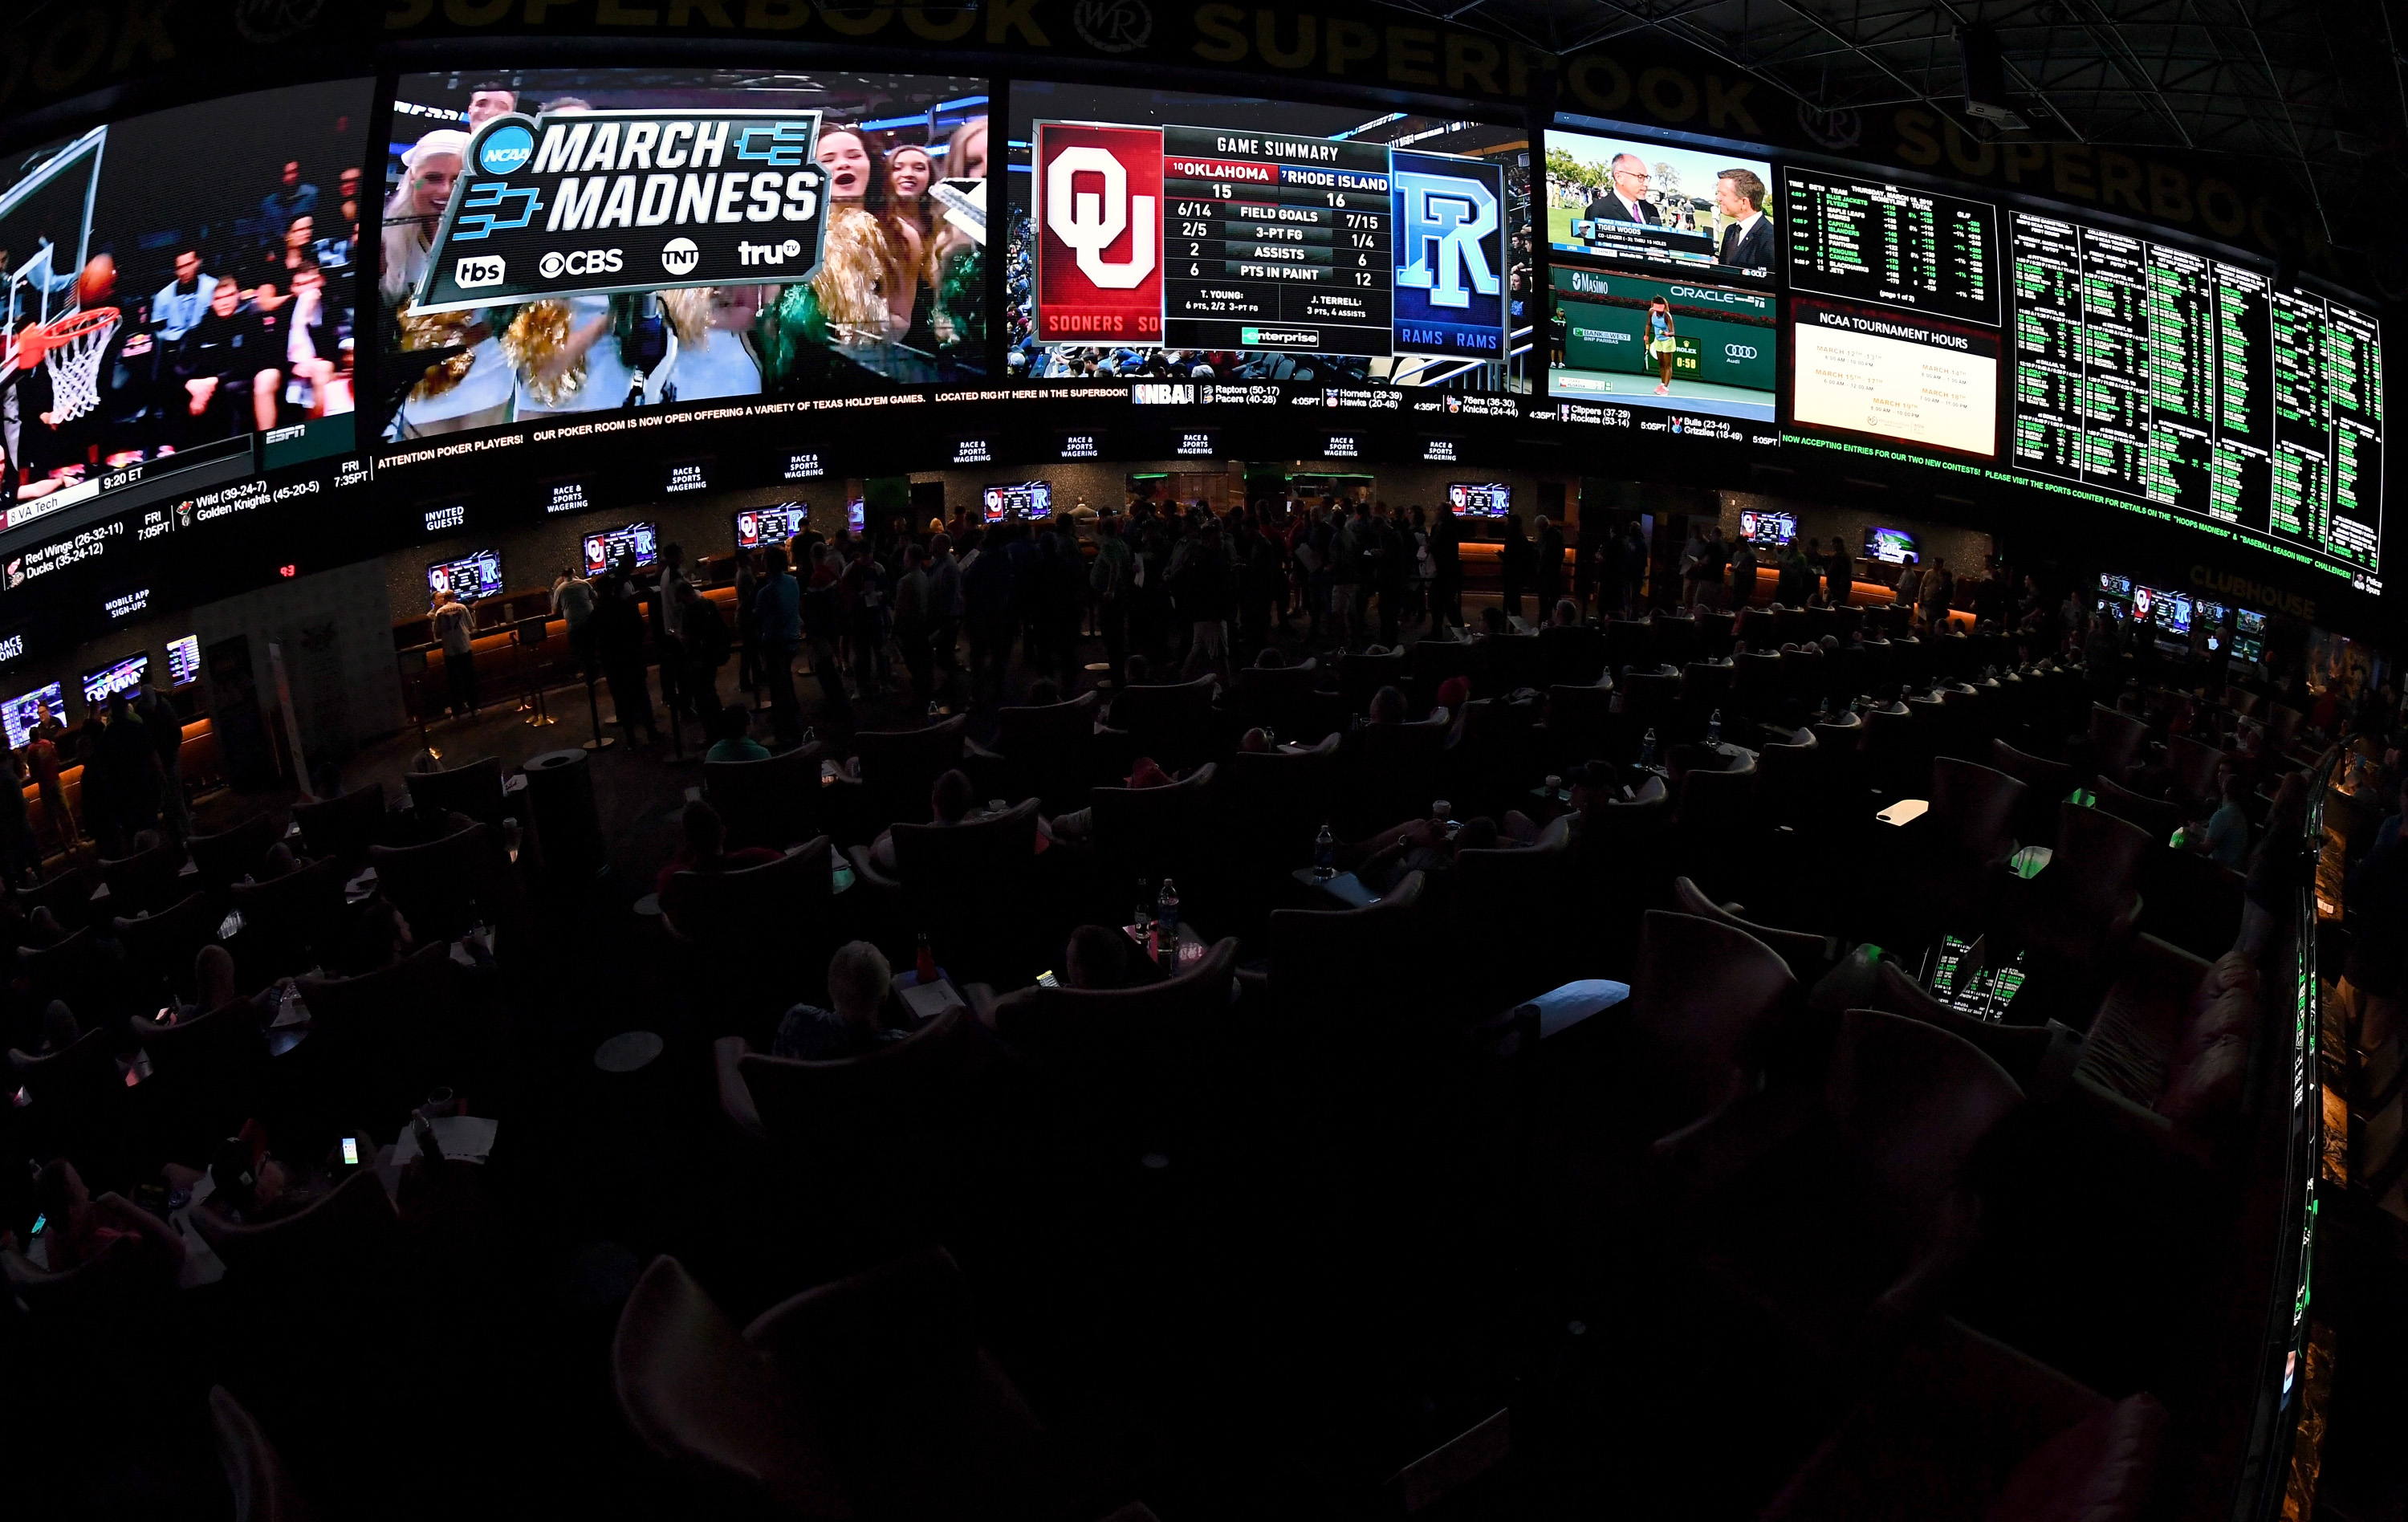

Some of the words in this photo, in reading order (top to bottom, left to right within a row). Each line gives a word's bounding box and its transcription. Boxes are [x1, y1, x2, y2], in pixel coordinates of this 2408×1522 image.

[483, 147, 531, 162] NCAA
[531, 121, 730, 173] MARCH
[1217, 136, 1258, 155] GAME
[1265, 140, 1339, 161] SUMMARY
[1185, 163, 1269, 181] OKLAHOMA
[1288, 170, 1334, 186] RHODE
[1338, 175, 1388, 191] ISLAND
[1212, 184, 1232, 199] 15
[545, 171, 818, 232] MADNESS
[1327, 193, 1345, 207] 16
[1178, 202, 1211, 218] 6/14
[1241, 207, 1275, 219] FIELD
[1279, 210, 1318, 222] GOALS
[1182, 222, 1206, 237] 2/5
[1346, 214, 1378, 230] 7/15
[1597, 223, 1616, 232] TIGER
[1617, 226, 1641, 235] WOODS
[1256, 227, 1284, 238] 3-PT
[1287, 229, 1303, 240] FG
[1352, 234, 1374, 248] 1/4
[1190, 242, 1199, 256] 2
[1255, 246, 1304, 259] ASSISTS
[565, 249, 623, 275] CBS
[662, 250, 699, 264] TNT
[1359, 254, 1367, 266] 6
[460, 259, 500, 282] tbs
[1190, 263, 1199, 276] 6
[1241, 266, 1263, 277] PTS
[1267, 267, 1279, 279] IN
[1283, 268, 1319, 280] PAINT
[1751, 270, 1767, 278] GOLF
[1355, 273, 1371, 287] 12
[1201, 290, 1208, 299] T.
[1210, 291, 1243, 300] YOUNG:
[1311, 295, 1319, 304] J.
[1320, 296, 1362, 306] TERRELL:
[1670, 286, 1735, 303] ORACLE
[1049, 315, 1123, 332] SOONERS
[1820, 312, 1850, 328] NCAA
[1852, 318, 1929, 341] TOURNAMENT
[1931, 332, 1968, 349] HOURS
[1245, 330, 1317, 344] enterprise
[1402, 328, 1442, 345] RAMS
[1457, 333, 1497, 349] RAMS
[1677, 357, 1696, 369] 0:58
[935, 390, 979, 401] LOCATED
[980, 389, 1011, 400] RIGHT
[1012, 389, 1037, 399] HERE
[1039, 389, 1047, 398] IN
[1050, 389, 1068, 397] THE
[1070, 389, 1128, 397] SUPERBOOK!
[1145, 384, 1186, 404] NBA
[1216, 385, 1247, 394] Raptors
[1250, 386, 1279, 396] (50-17)
[1340, 389, 1371, 398] Hornets
[1373, 391, 1402, 401] (29-39)
[1216, 395, 1244, 403] Pacers
[1246, 395, 1276, 405] (40-28)
[1291, 397, 1320, 405] 4:05PT
[1340, 398, 1366, 407] Hawks
[1369, 399, 1398, 409] (20-48)
[534, 430, 555, 442] OUR
[558, 424, 592, 438] POKER
[595, 421, 625, 433] ROOM
[628, 418, 637, 429] IS
[639, 416, 662, 427] NOW
[665, 413, 692, 424] OPEN
[694, 408, 743, 421] OFFERING
[746, 407, 753, 415] A
[755, 403, 795, 414] VARIETY
[797, 401, 810, 410] OF
[813, 399, 843, 409] TEXAS
[845, 397, 888, 407] HOLD'EM
[890, 394, 925, 404] GAMES.
[266, 425, 305, 446] ESPN
[378, 450, 435, 469] ATTENTION
[437, 443, 473, 458] POKER
[474, 434, 523, 450] PLAYERS!
[791, 455, 810, 463] RACE
[812, 454, 818, 462] &
[1178, 447, 1213, 455] WAGERING
[1783, 434, 1800, 444] NOW
[1801, 437, 1842, 450] ACCEPTING
[1844, 443, 1873, 455] ENTRIES
[1875, 448, 1889, 458] FOR
[1891, 451, 1906, 462] OUR
[1908, 454, 1923, 464] TWO
[1925, 458, 1941, 468] NEW
[1942, 462, 1980, 476] CONTESTS!
[342, 461, 359, 474] FRI
[784, 468, 824, 479] WAGERING
[790, 462, 819, 471] SPORTS
[104, 473, 126, 490] 9:20
[128, 467, 143, 482] ET
[334, 470, 368, 488] 7:35PT
[196, 492, 219, 509] Wild
[221, 481, 267, 503] (39-24-7)
[554, 486, 574, 495] RACE
[576, 485, 582, 493] &
[197, 502, 232, 521] Golden
[234, 494, 271, 515] Knights
[273, 481, 319, 503] (45-20-5)
[547, 499, 588, 513] WAGERING
[553, 493, 582, 504] SPORTS
[18, 505, 33, 520] VA
[34, 496, 58, 515] Tech
[425, 506, 464, 522] INVITED
[144, 511, 161, 527] FRI
[427, 516, 464, 531] GUESTS
[1985, 470, 2011, 482] PLEASE
[2012, 474, 2029, 486] VISIT
[2031, 479, 2043, 489] THE
[2045, 482, 2071, 495] SPORTS
[2072, 490, 2103, 507] COUNTER
[2105, 497, 2119, 509] FOR
[2120, 501, 2146, 516] DETAILS
[2148, 507, 2158, 517] ON
[2159, 510, 2170, 521] THE
[2173, 515, 2197, 530] "HOOPS
[2199, 521, 2231, 539] MADNESS"
[2239, 535, 2272, 553] "BASEBALL
[2272, 544, 2295, 560] SEASON
[2296, 551, 2312, 565] WINS"
[2314, 561, 2351, 580] CHALLENGES!
[138, 521, 170, 541] 7:05PT
[25, 547, 42, 565] Red
[44, 540, 73, 560] Wings
[75, 521, 124, 551] (26-32-11)
[26, 560, 54, 580] Ducks
[55, 543, 104, 571] (35-24-12)
[105, 593, 133, 611] MOBILE
[135, 589, 150, 602] APP
[2190, 565, 2316, 622] CLUBHOUSE
[112, 600, 147, 618] SIGN-UPS
